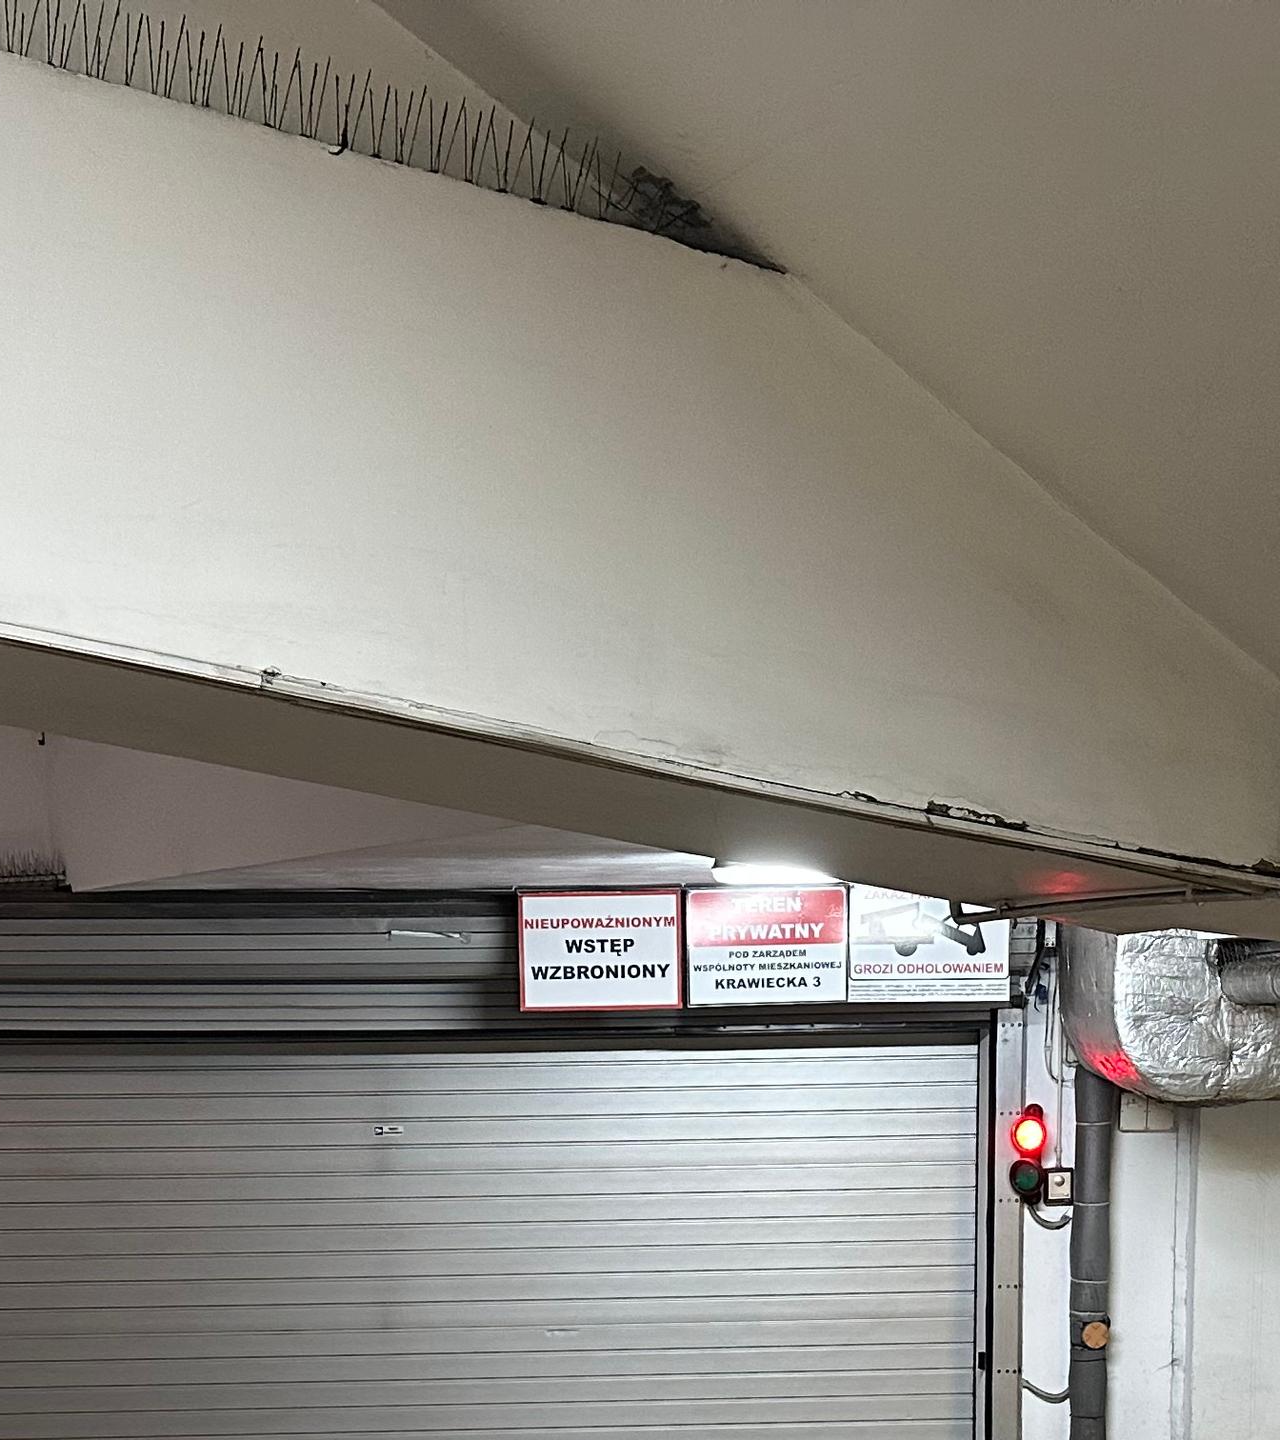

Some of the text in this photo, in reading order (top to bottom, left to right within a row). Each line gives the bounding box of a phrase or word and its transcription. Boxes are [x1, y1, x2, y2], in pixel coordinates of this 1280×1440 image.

[730, 896, 802, 913] TEREN
[524, 914, 675, 930] NIEUPOWAŻNIONYM
[707, 922, 825, 941] PRYWATNY
[565, 938, 635, 956] WSTĘP
[728, 949, 807, 959] POD ZARZĄDEM
[531, 963, 671, 980] WZBRONIONY
[693, 961, 842, 972] WSPÓLNOTY MIESZKANIOWEJ
[853, 962, 1004, 974] GROZI ODHOLOWANIEM
[715, 976, 821, 990] KRAWIECKA 3
